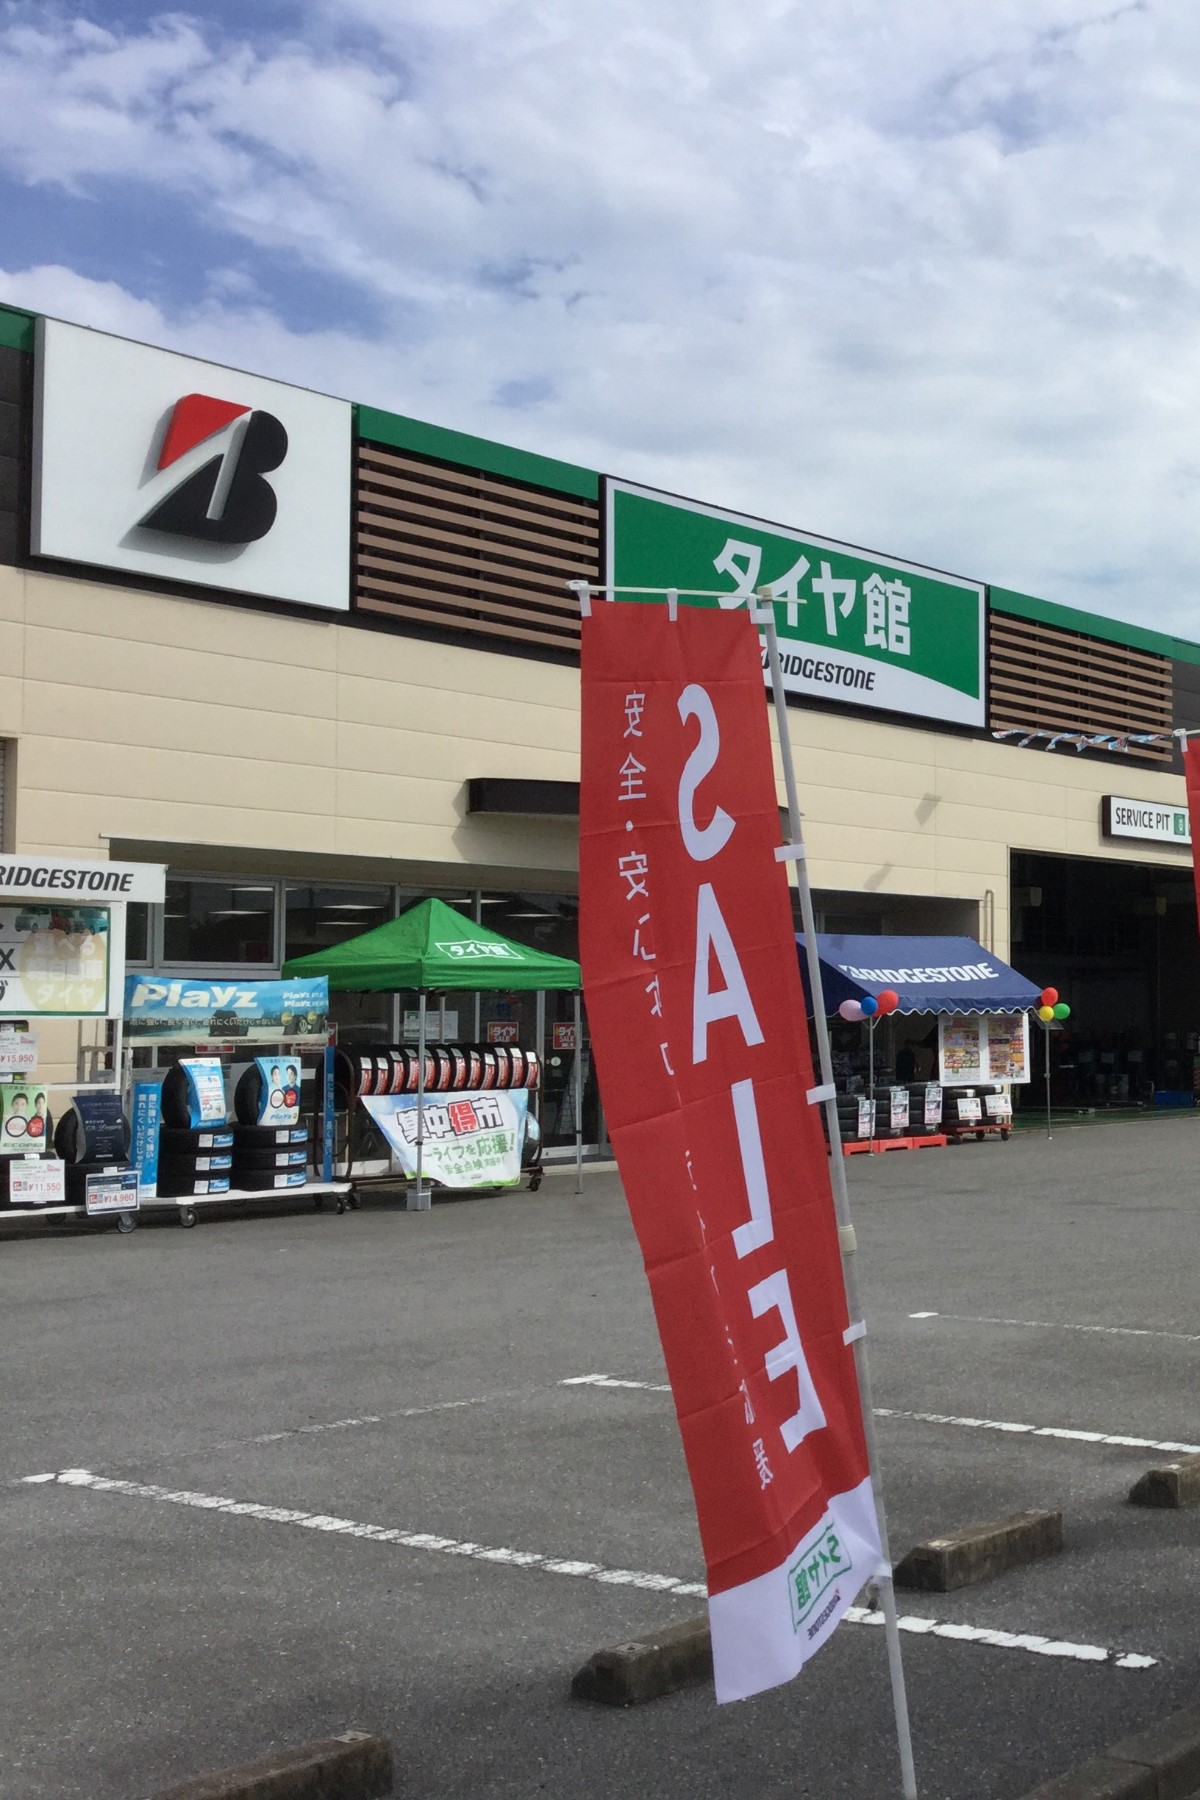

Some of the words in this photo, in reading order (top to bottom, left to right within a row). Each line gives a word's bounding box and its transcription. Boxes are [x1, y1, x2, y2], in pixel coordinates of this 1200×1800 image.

[712, 538, 911, 656] タイヤ館
[761, 651, 876, 691] RIDGESTONE
[1115, 806, 1154, 829] SERVICE
[1155, 812, 1171, 832] PIT
[0, 865, 135, 893] RIDGESTONE
[838, 963, 999, 984] BRIDGESTONE
[130, 983, 258, 1009] Playz
[396, 1096, 504, 1145] 集中得市
